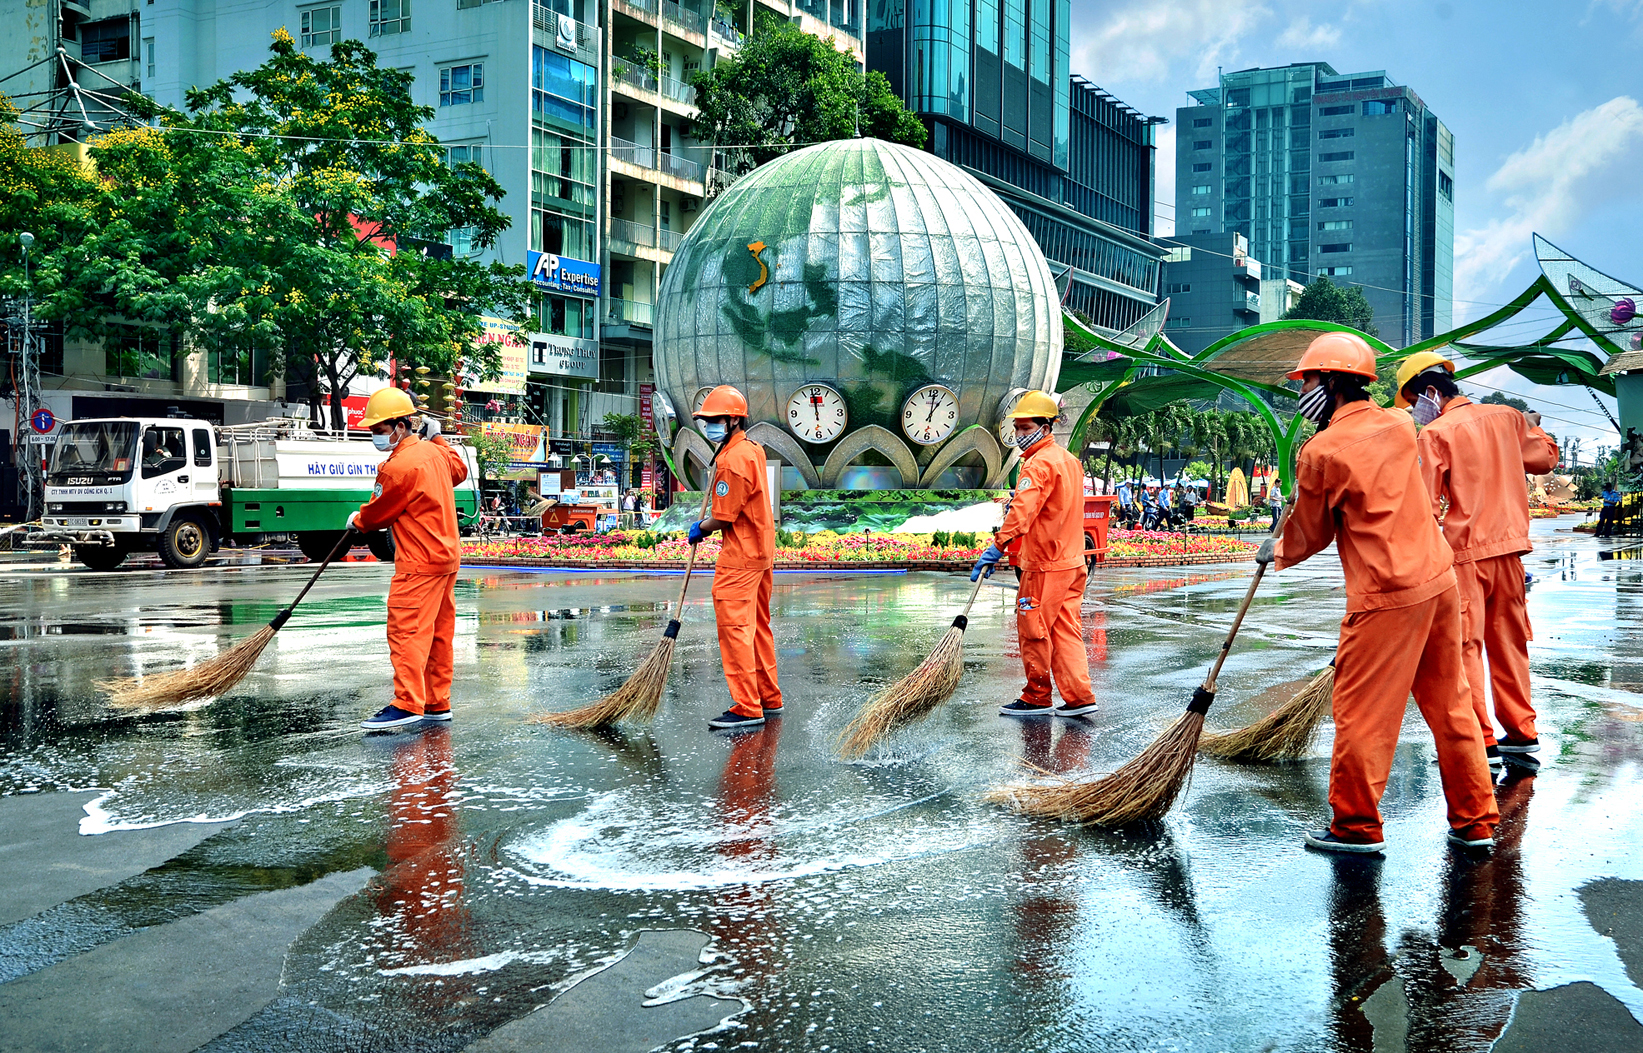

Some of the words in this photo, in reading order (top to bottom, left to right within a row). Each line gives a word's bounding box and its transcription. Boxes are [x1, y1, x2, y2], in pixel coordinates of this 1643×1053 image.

[561, 268, 599, 287] Expertise
[573, 285, 599, 296] Consulting
[559, 360, 586, 369] GROUP
[810, 388, 821, 396] 12
[928, 389, 939, 398] 12
[790, 410, 798, 418] 9
[836, 409, 844, 417] 3
[905, 411, 912, 419] 9
[948, 411, 955, 419] 3
[815, 430, 823, 439] 6
[924, 432, 930, 440] 6
[1008, 435, 1014, 443] 6
[307, 461, 326, 475] HÃY
[67, 477, 94, 485] ISUZU
